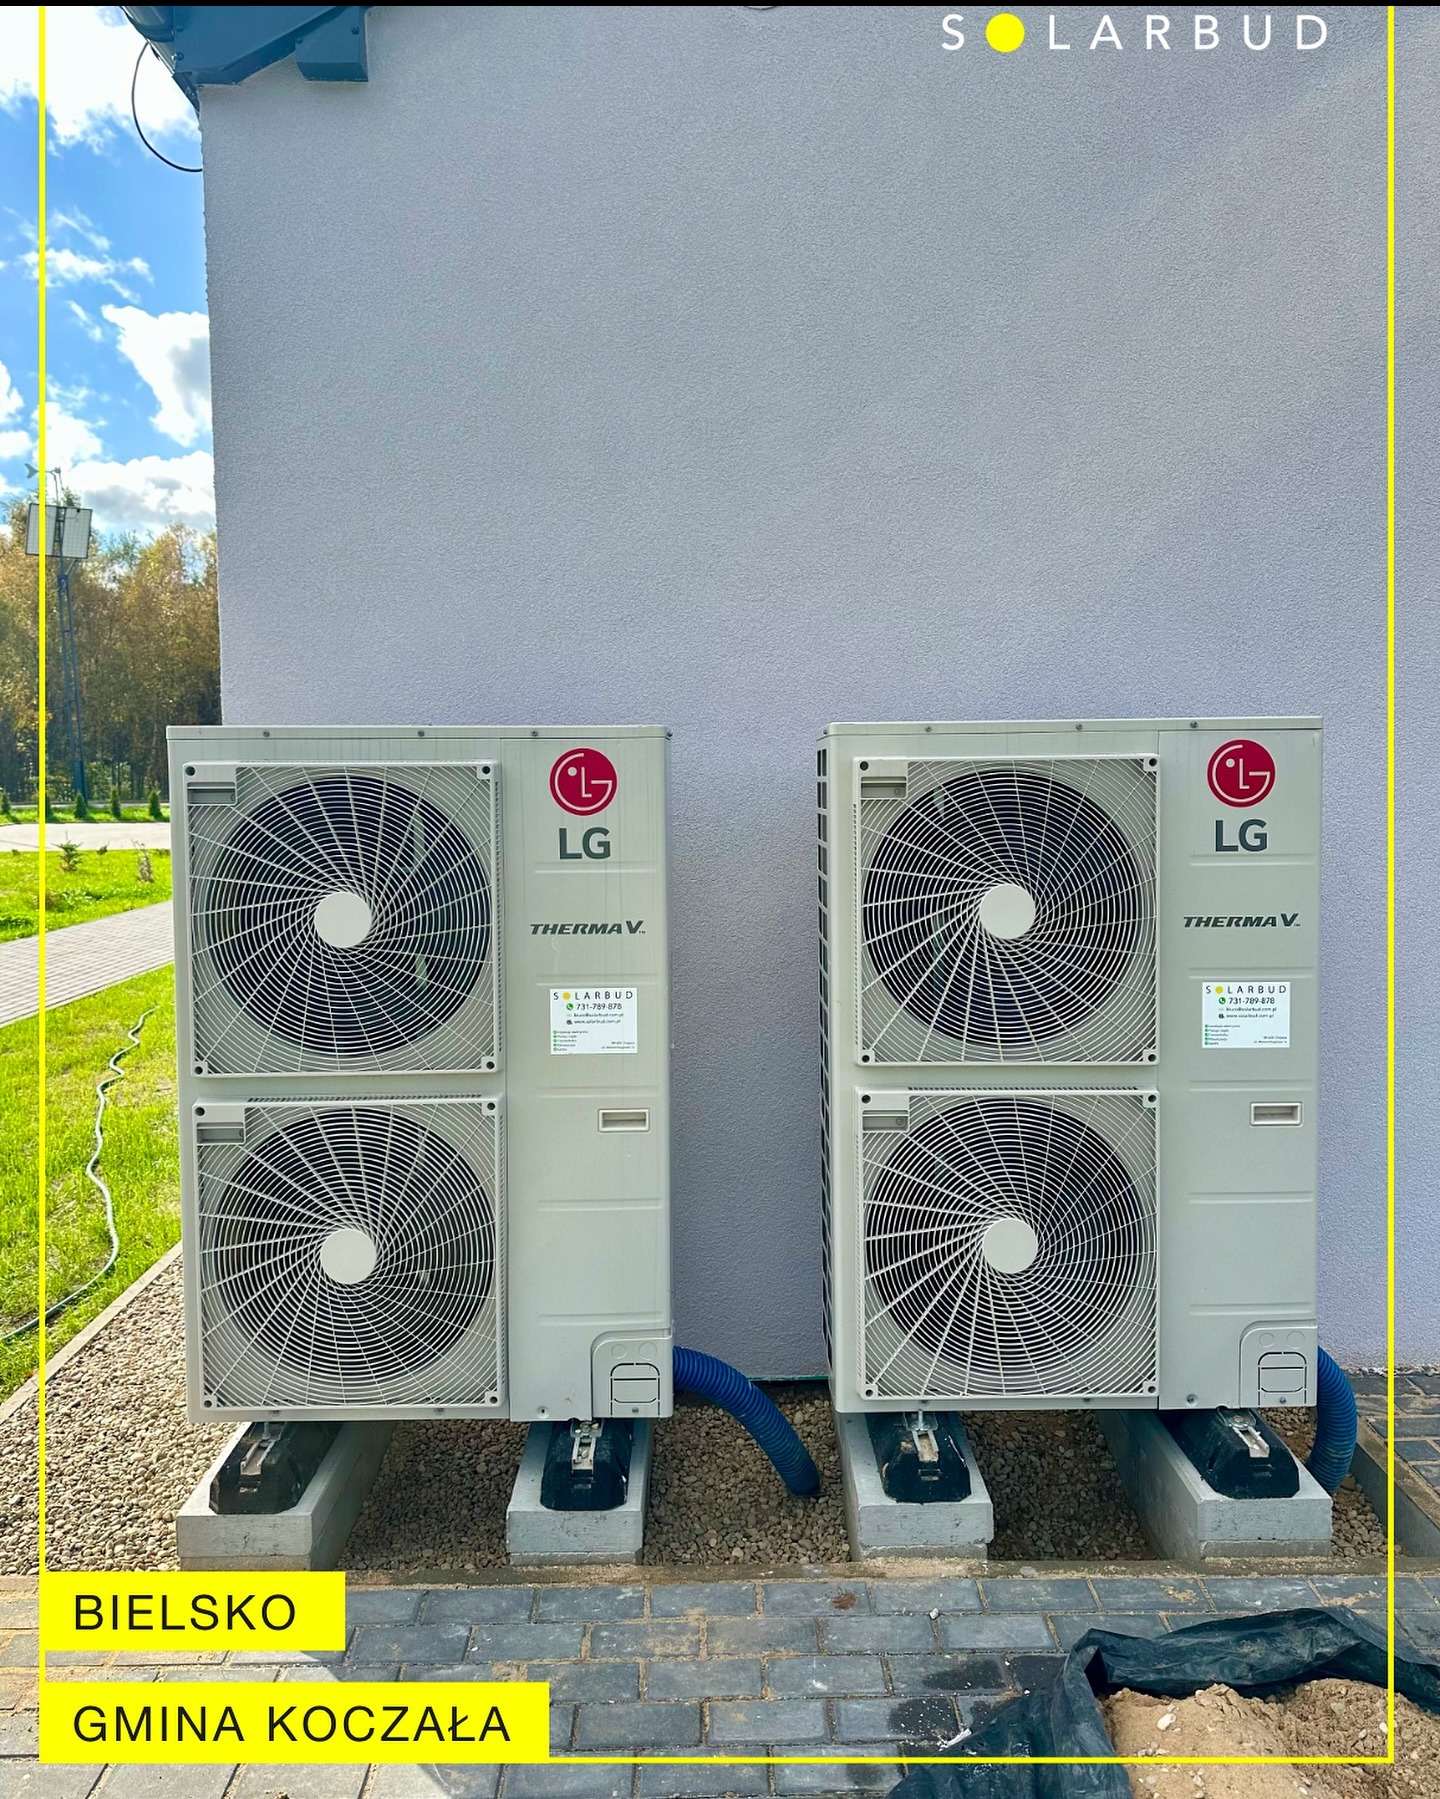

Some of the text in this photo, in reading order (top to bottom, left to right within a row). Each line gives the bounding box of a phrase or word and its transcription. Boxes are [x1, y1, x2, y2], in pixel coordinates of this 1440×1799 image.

[1215, 818, 1268, 852] LG
[558, 826, 611, 860] LG
[1205, 985, 1286, 994] SOLARBUD
[553, 991, 633, 1000] SOLARBUD
[1228, 997, 1275, 1005] 731-789-878
